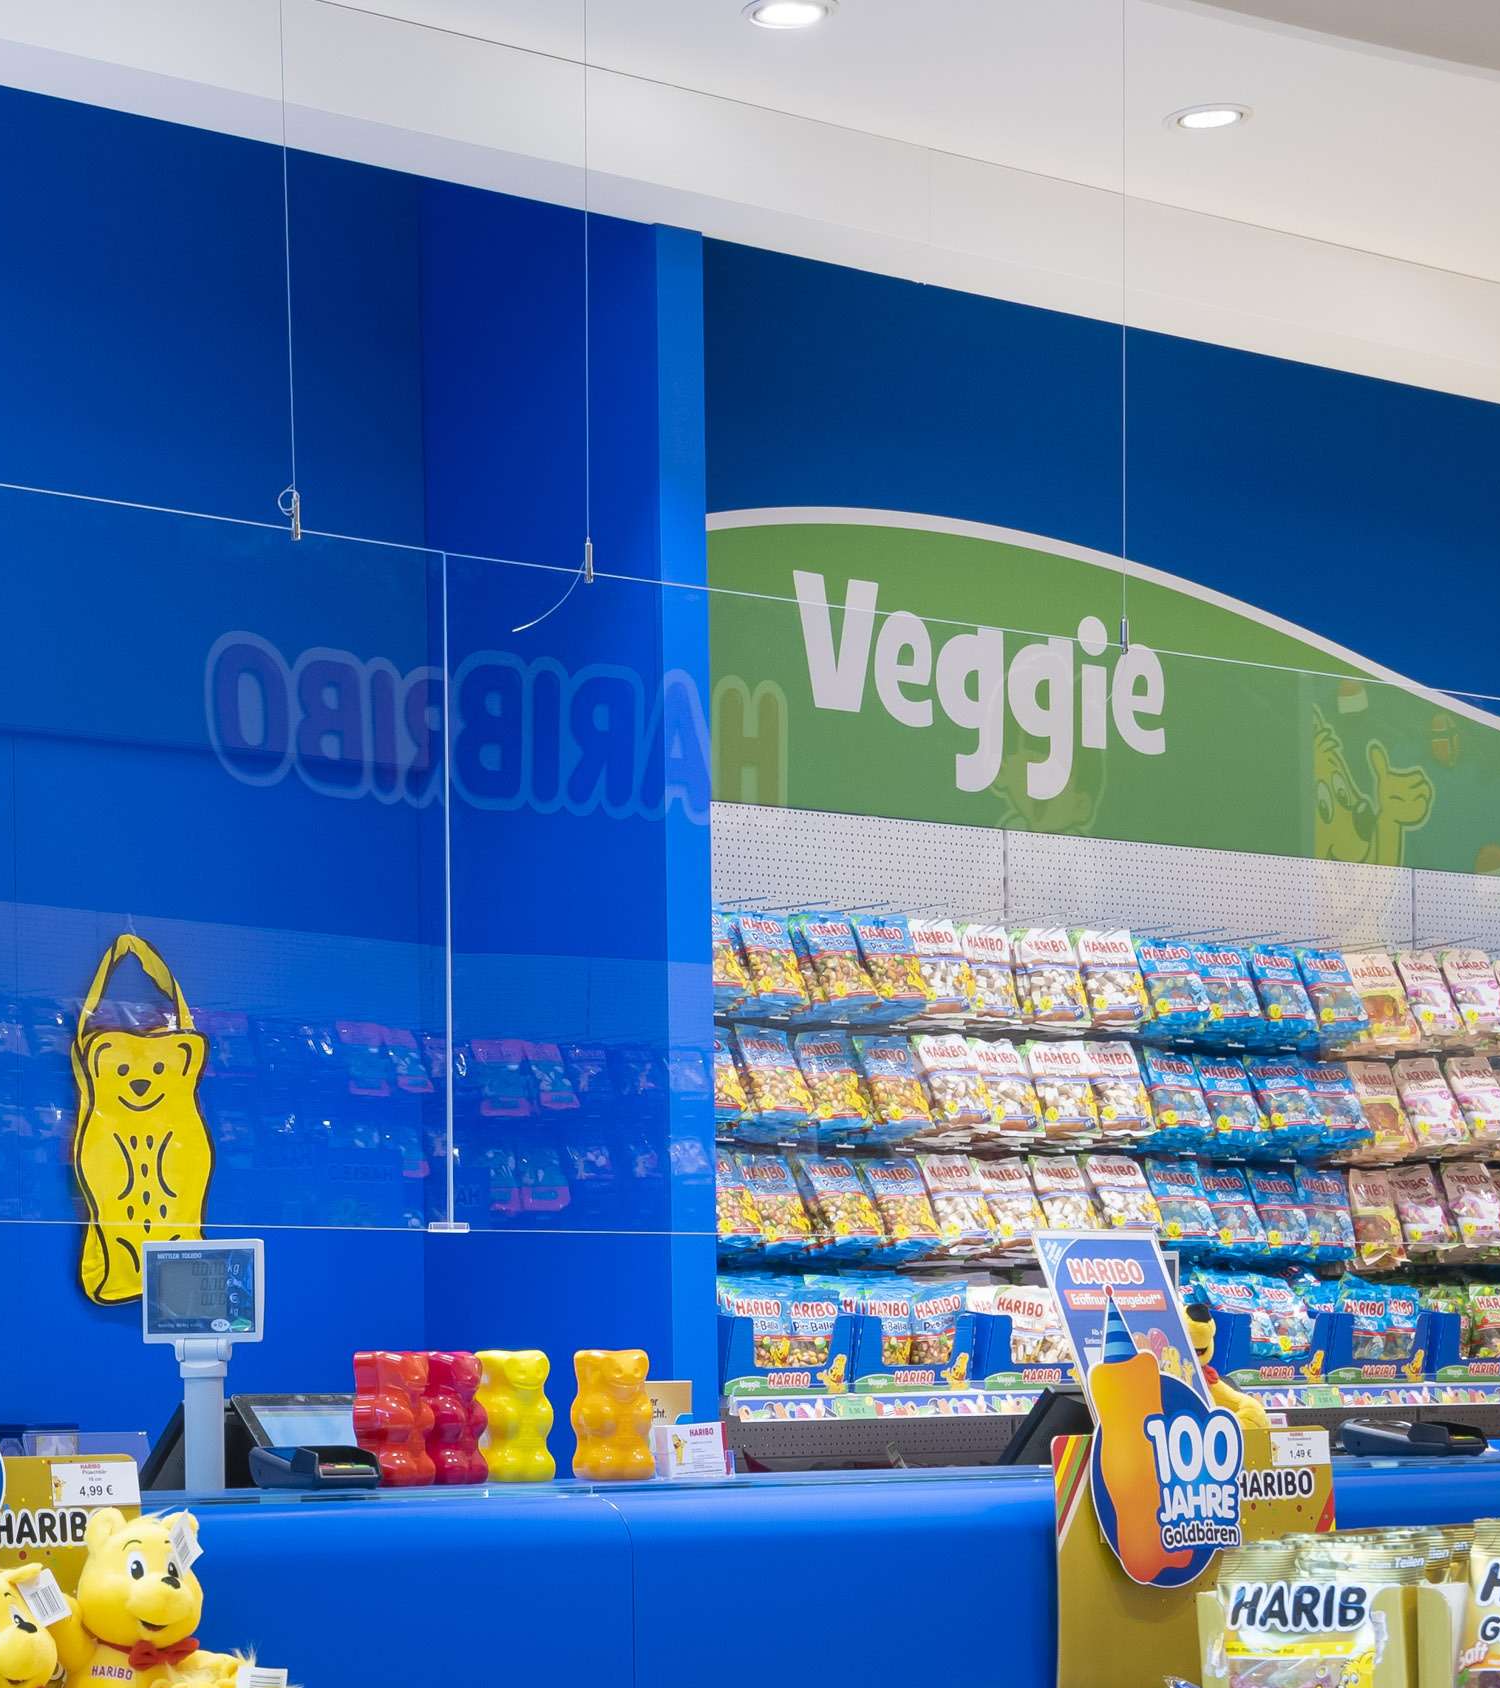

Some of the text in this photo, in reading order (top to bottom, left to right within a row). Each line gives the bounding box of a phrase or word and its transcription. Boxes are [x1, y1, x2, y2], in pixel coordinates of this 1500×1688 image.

[793, 570, 1167, 800] Veggie
[1067, 1259, 1144, 1284] HARIBO
[736, 1299, 781, 1316] HARIBO
[868, 1299, 909, 1317] HARIBO
[914, 1296, 961, 1319] HARIBO
[997, 1297, 1044, 1318] HARIBO
[1022, 1369, 1061, 1385] HARIBO
[1259, 1363, 1295, 1381] HARIBO
[1361, 1363, 1396, 1381] HARIBO
[1469, 1361, 1500, 1377] HARIBO
[768, 1372, 810, 1388] HARIBO
[894, 1370, 935, 1387] HARIBO
[689, 1427, 714, 1437] HARIBO
[1147, 1415, 1240, 1484] 100
[1290, 1449, 1311, 1459] 1,49 €
[80, 1485, 113, 1498] 4,99 €
[1160, 1484, 1235, 1522] JAHRE
[1163, 1525, 1238, 1547] Goldbären
[1229, 1585, 1368, 1629] HARIB
[91, 1665, 134, 1681] HARIBO
